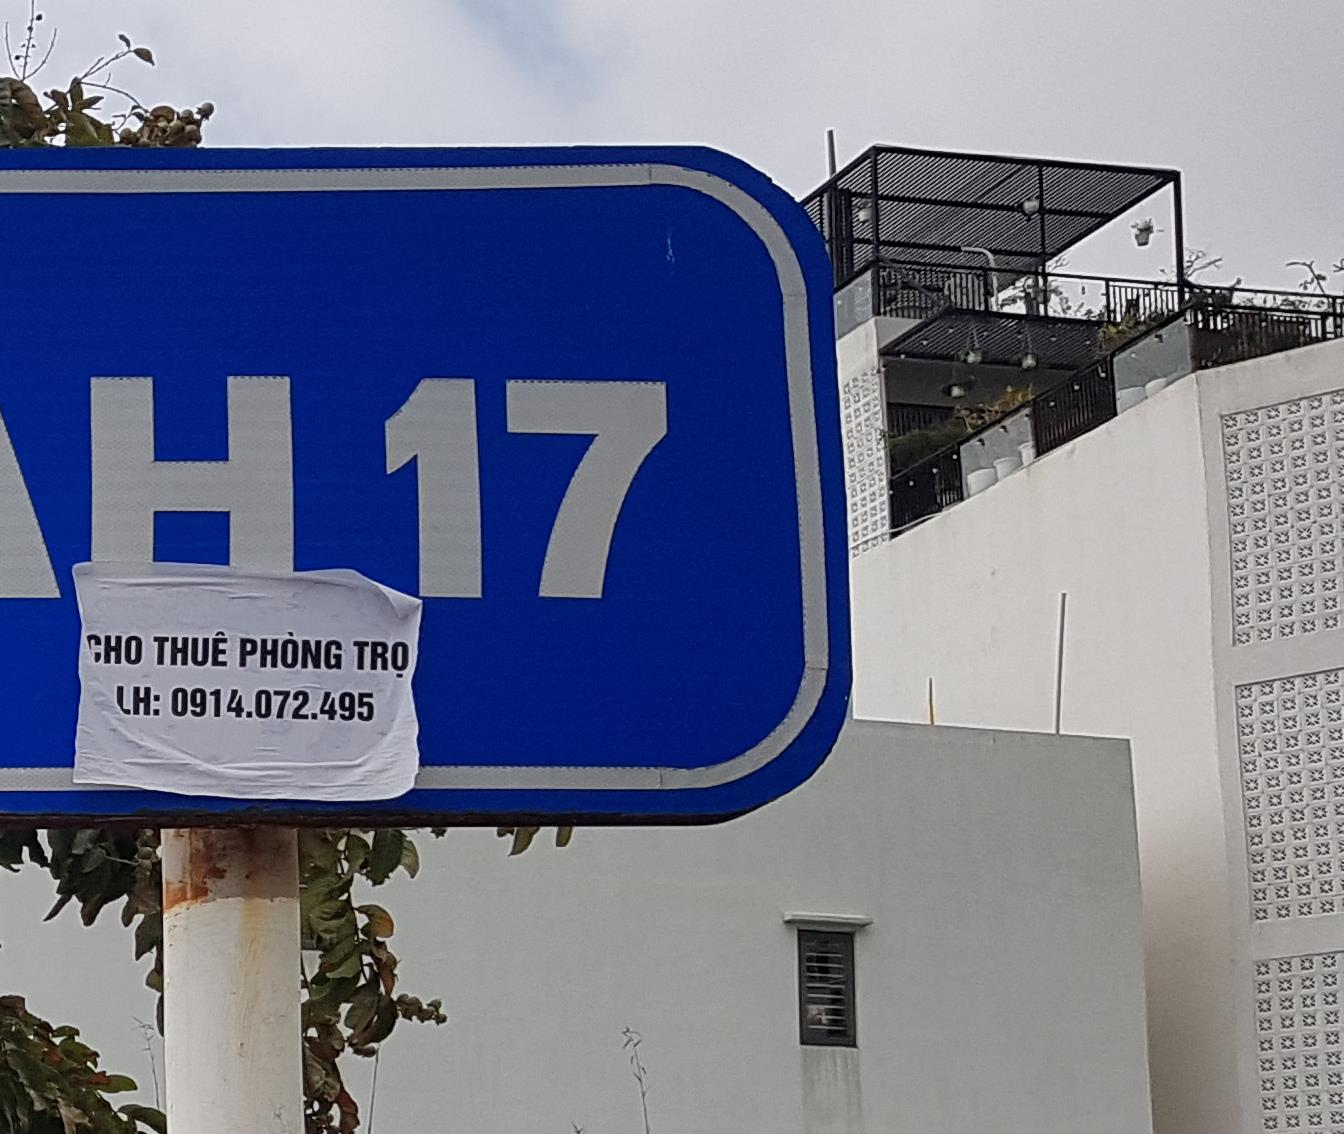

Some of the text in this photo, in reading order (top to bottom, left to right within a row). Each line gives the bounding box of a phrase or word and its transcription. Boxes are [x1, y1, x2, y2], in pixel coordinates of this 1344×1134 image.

[384, 376, 668, 600] 17
[153, 631, 228, 667] THUÊ
[239, 631, 342, 670] PHÒNG
[352, 640, 410, 678] TRỌ
[116, 685, 375, 722] LH: 0914.072.495
